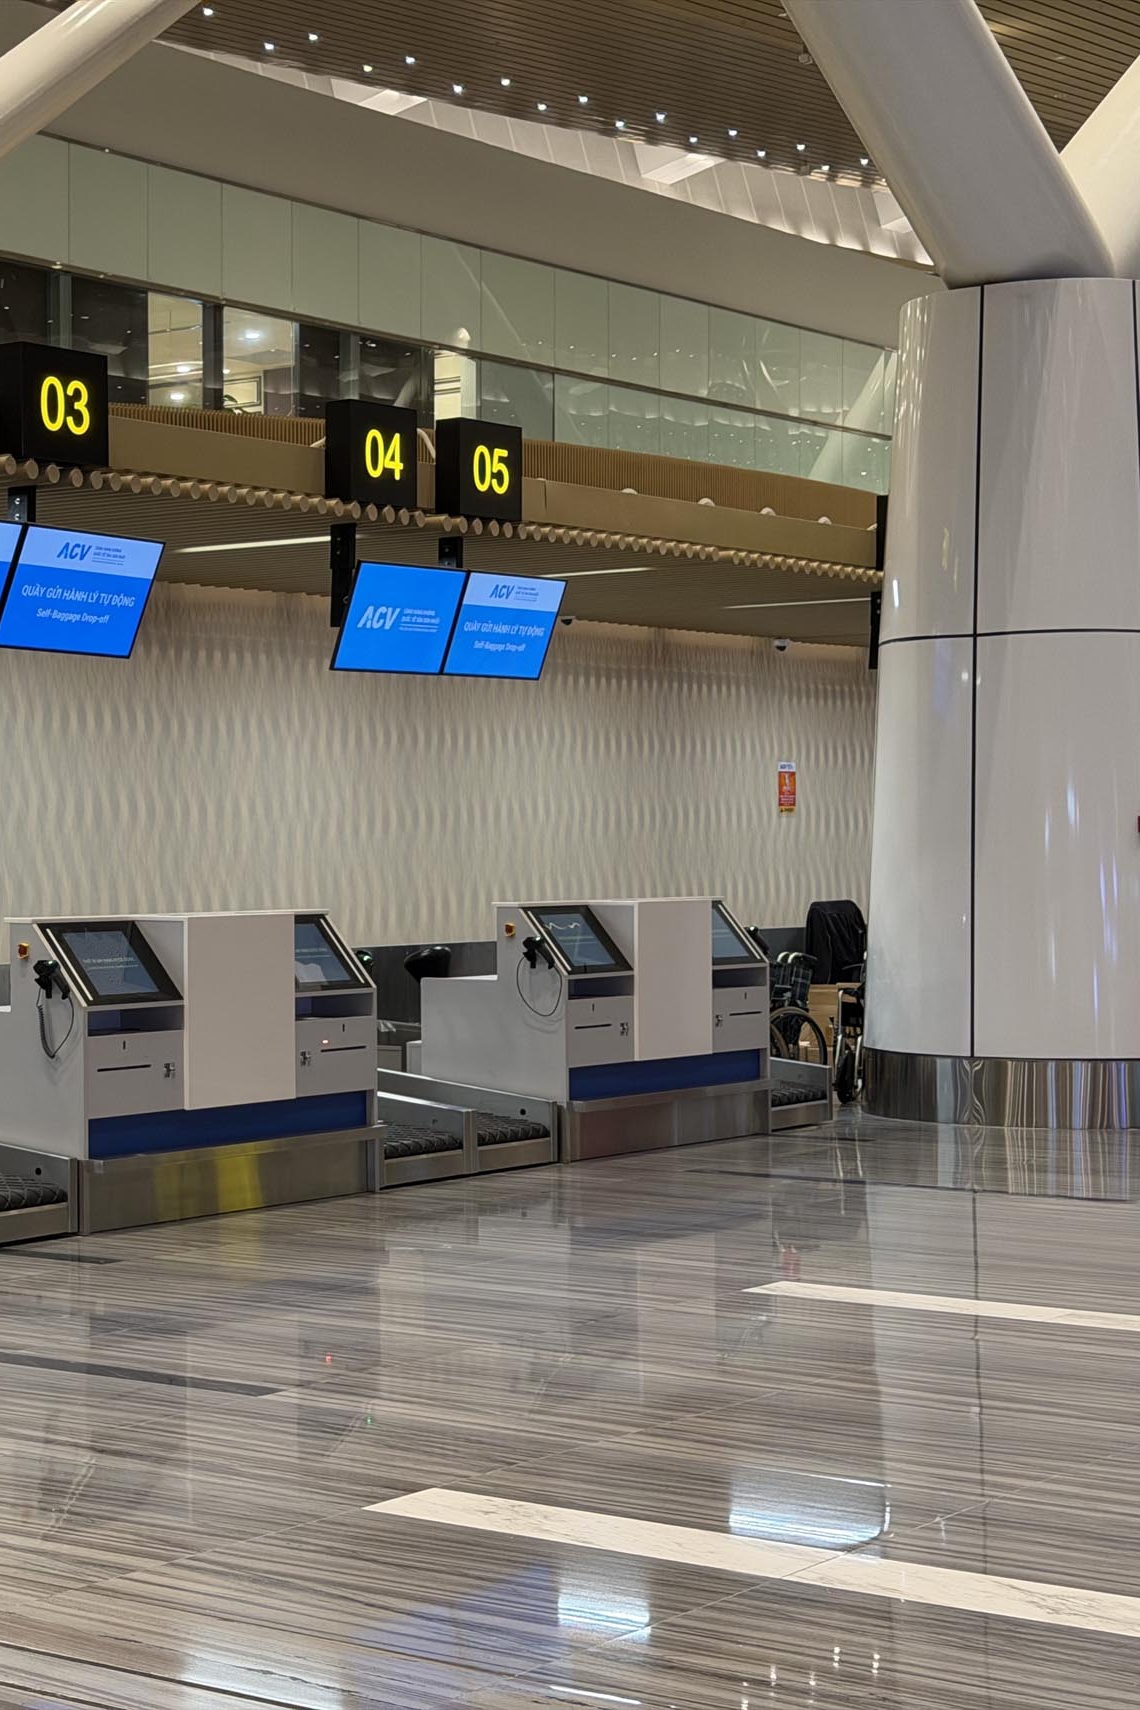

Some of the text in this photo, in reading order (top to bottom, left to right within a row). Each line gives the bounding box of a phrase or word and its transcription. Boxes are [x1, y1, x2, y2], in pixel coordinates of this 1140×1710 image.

[40, 376, 91, 436] 03
[364, 428, 403, 480] 04
[472, 444, 510, 495] 05
[57, 542, 92, 561] ACV
[46, 585, 62, 599] GỬI
[62, 587, 88, 602] HÀNH
[88, 590, 99, 603] LÝ
[99, 592, 113, 607] TỰ
[111, 593, 135, 607] ĐỘNG
[489, 583, 515, 600] ACV
[37, 607, 110, 625] Self-Baggage Drop-off
[357, 605, 400, 630] ACV
